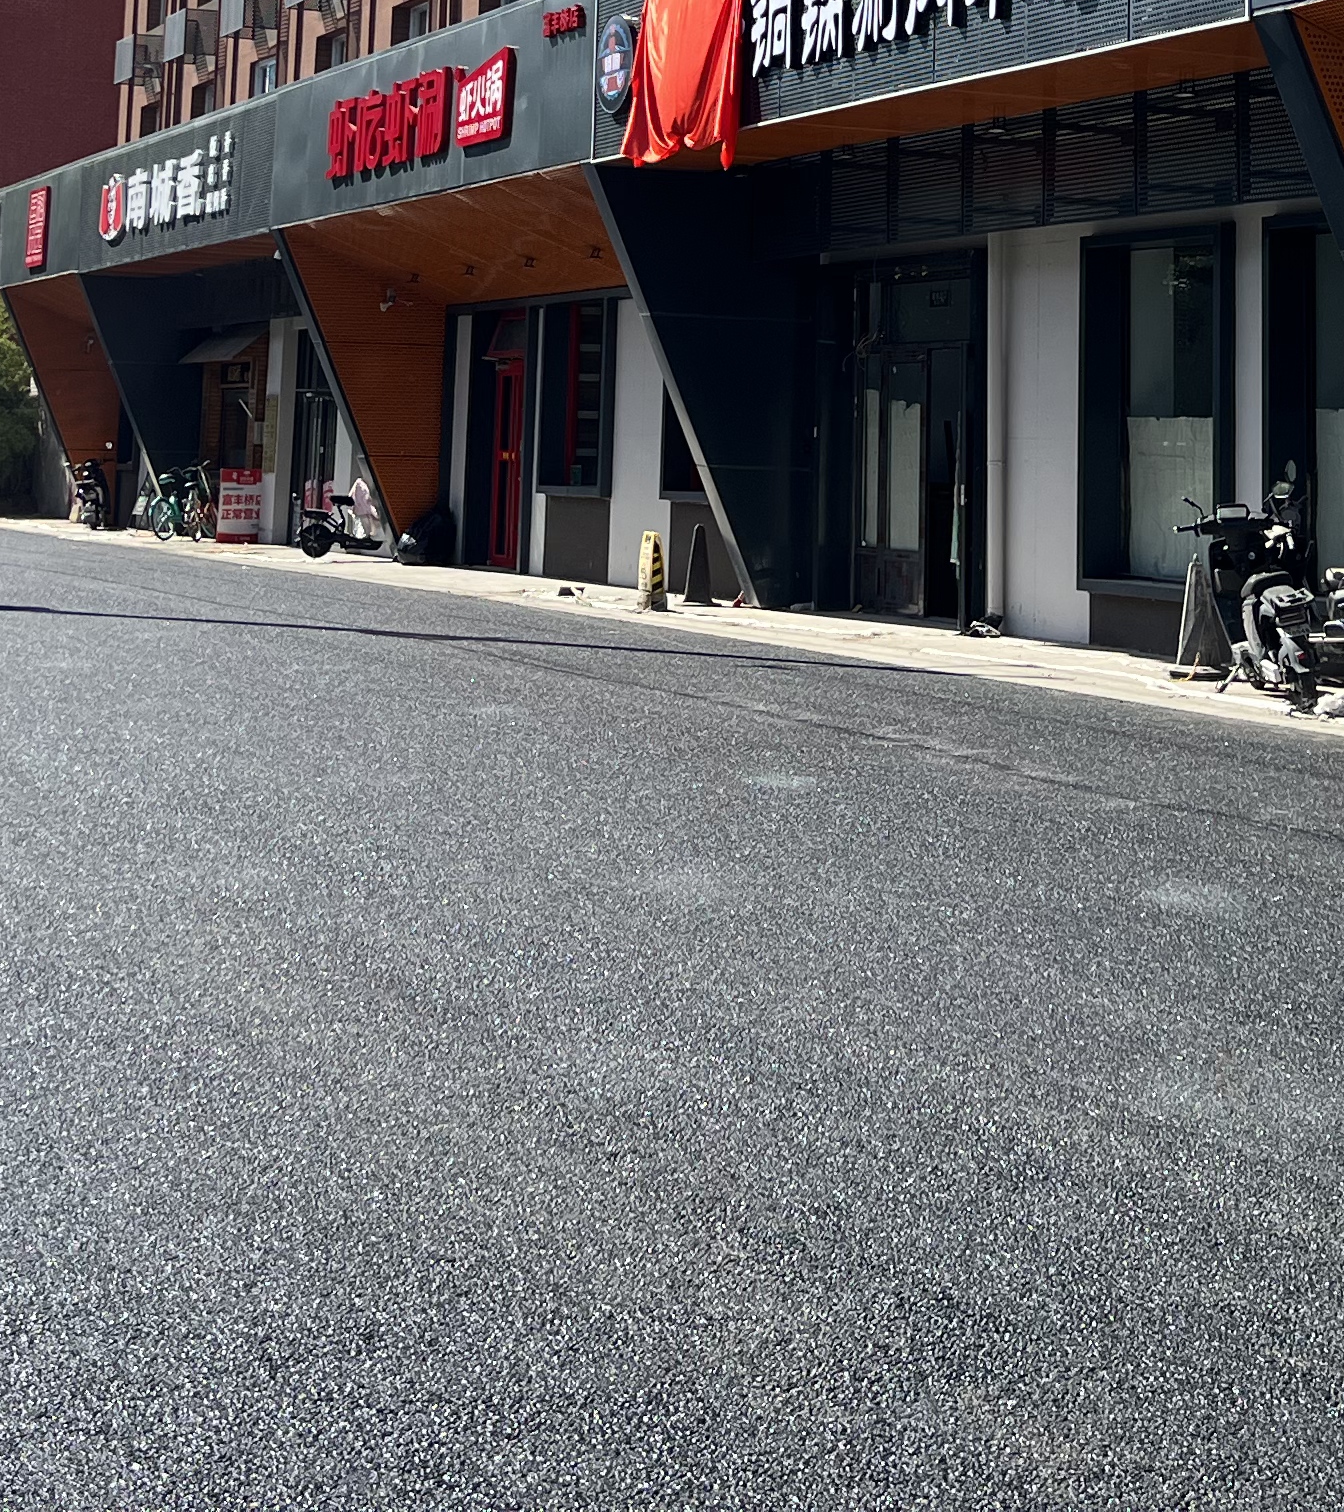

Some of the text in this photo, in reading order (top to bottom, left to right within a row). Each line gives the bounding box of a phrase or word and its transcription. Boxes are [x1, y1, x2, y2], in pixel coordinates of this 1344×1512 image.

[325, 66, 453, 179] 虾吃虾涮
[459, 60, 504, 122] 虾火锅
[126, 149, 205, 232] 南城香
